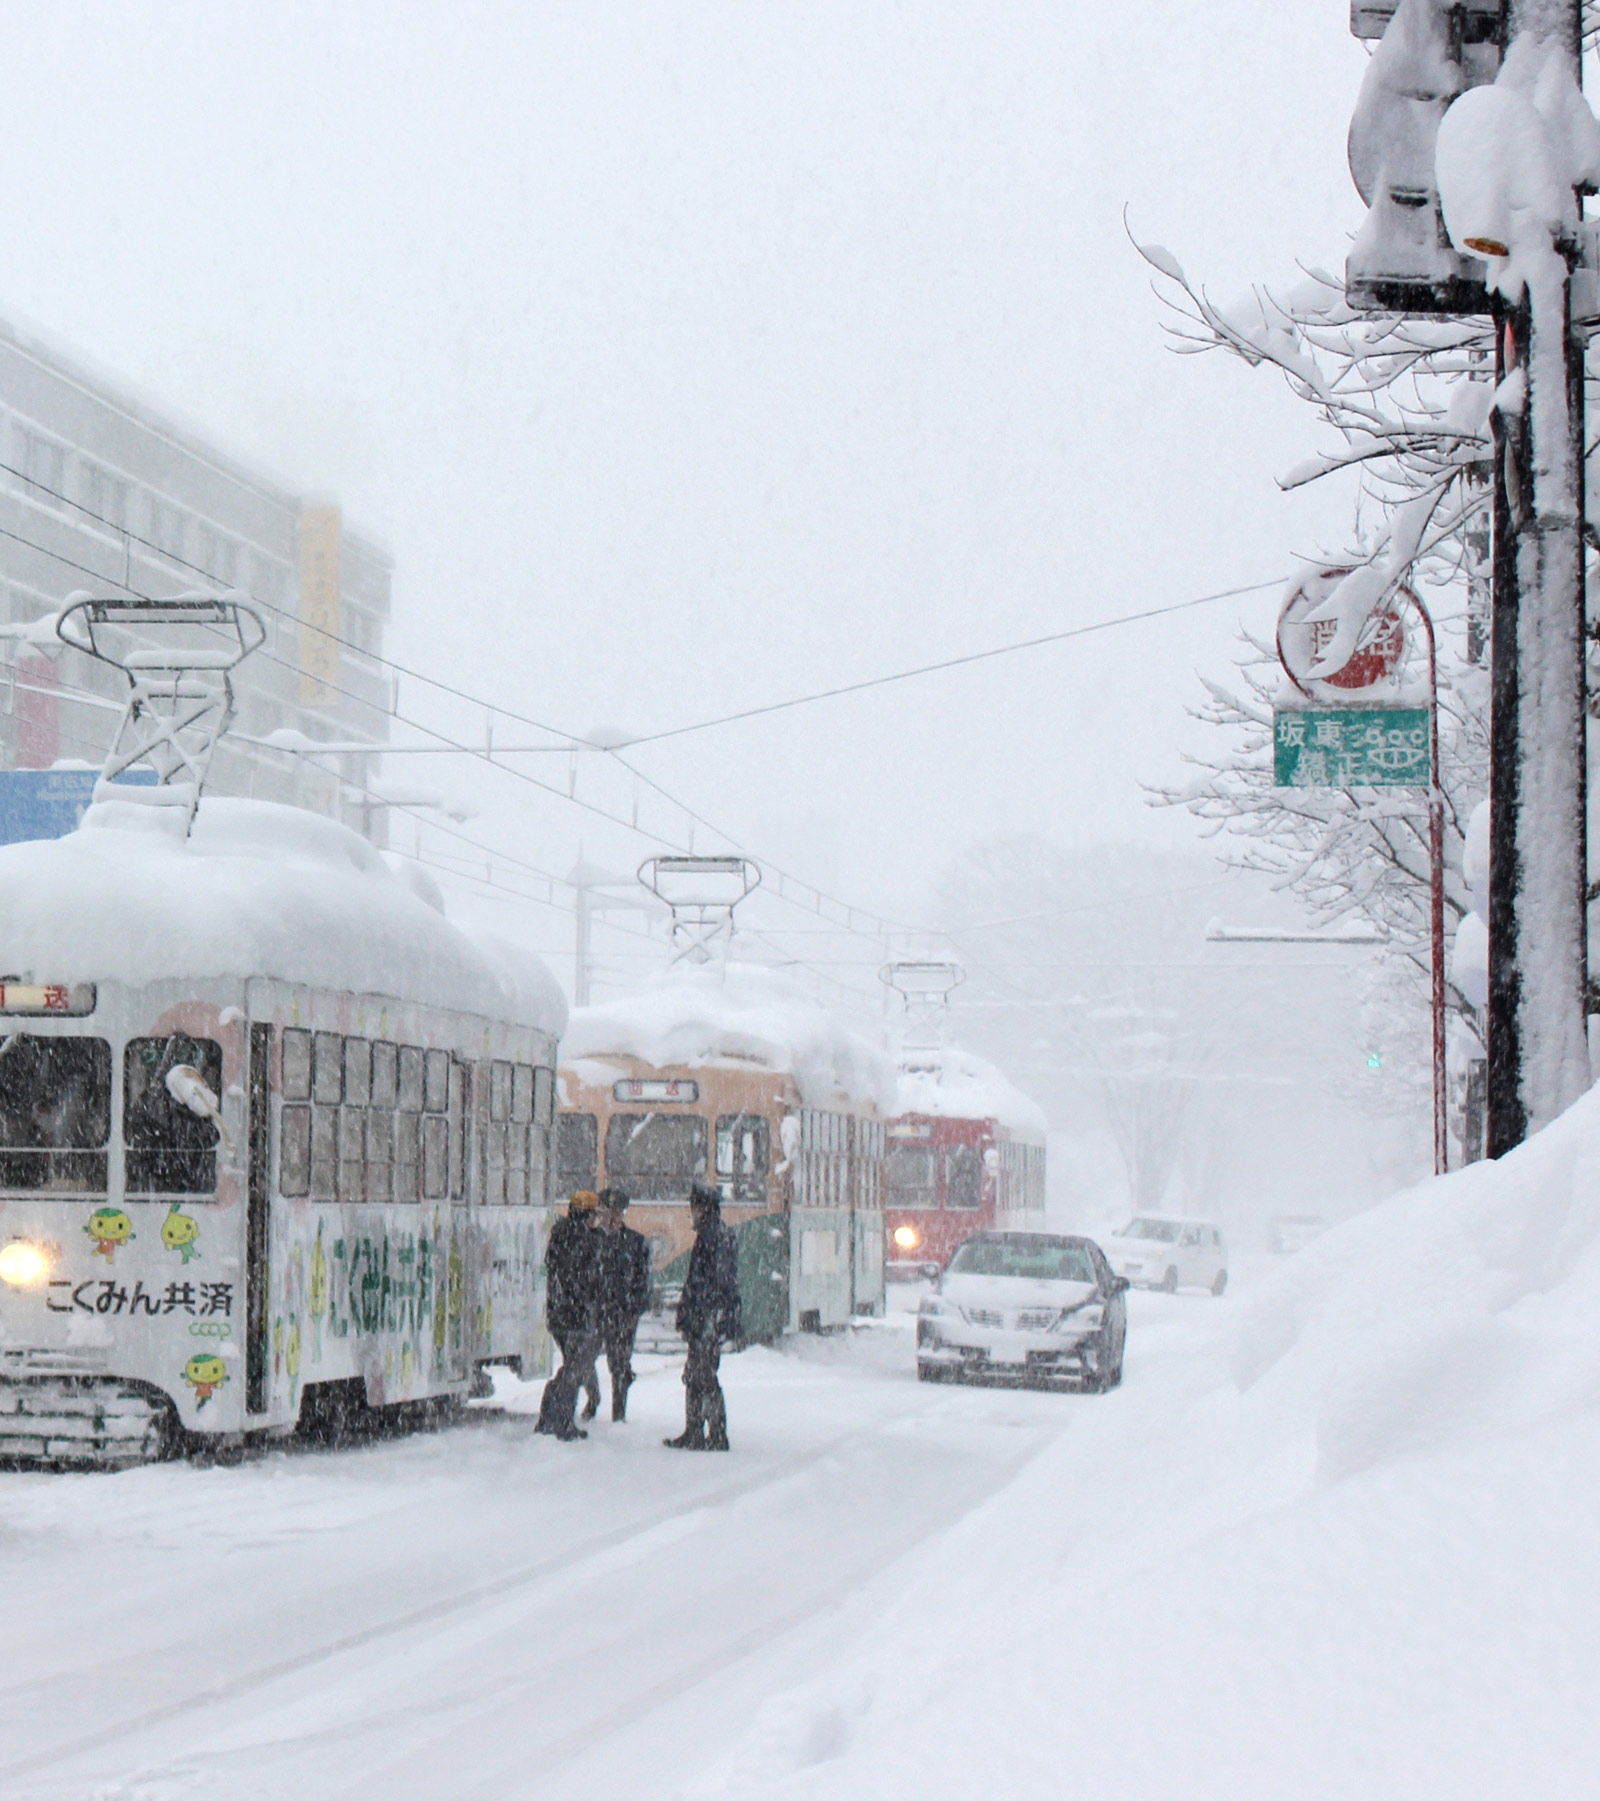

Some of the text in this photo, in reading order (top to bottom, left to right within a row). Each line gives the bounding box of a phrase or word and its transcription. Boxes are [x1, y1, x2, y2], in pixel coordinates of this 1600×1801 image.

[46, 1280, 233, 1316] こくみん共済
